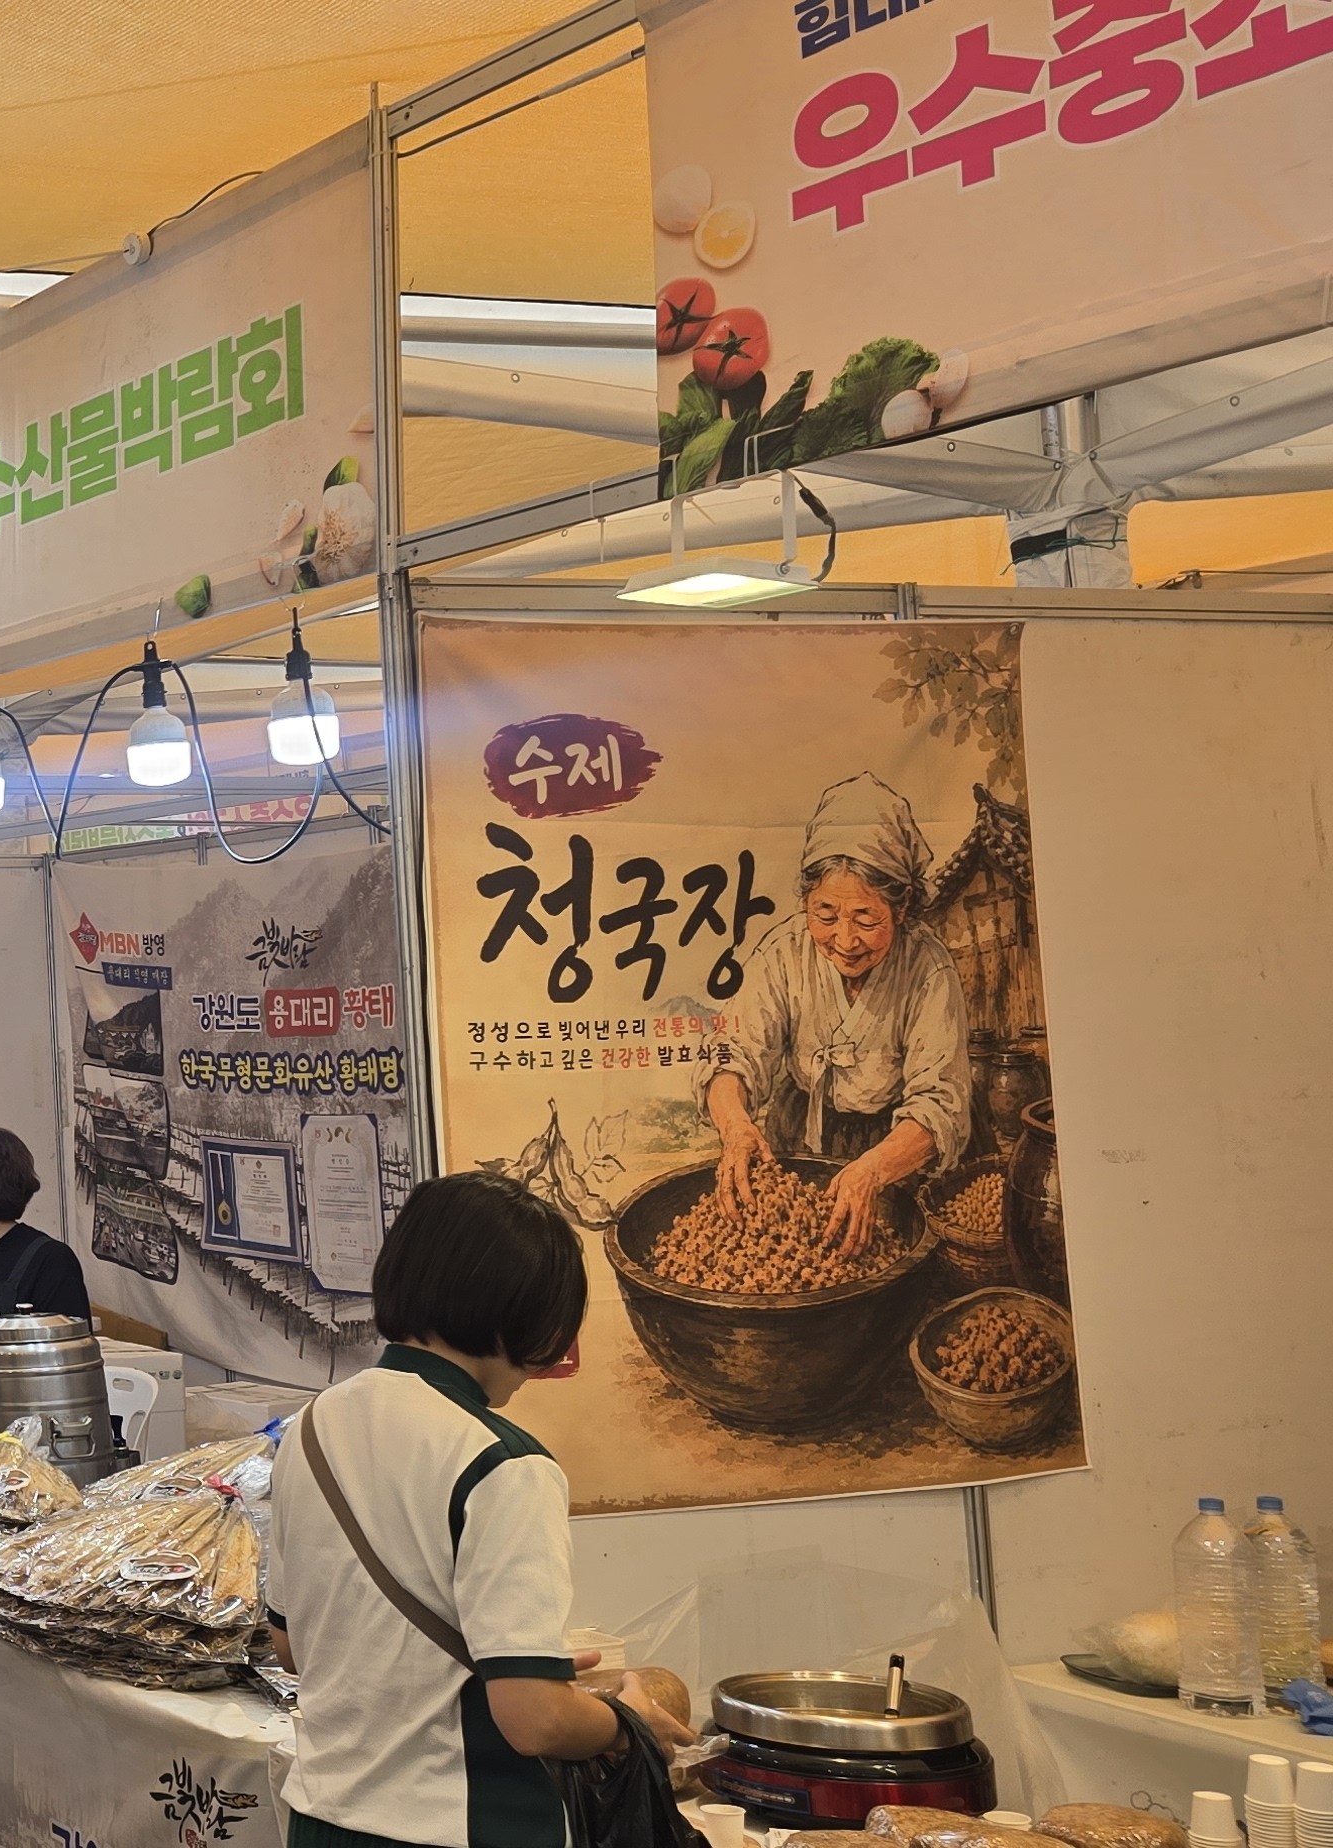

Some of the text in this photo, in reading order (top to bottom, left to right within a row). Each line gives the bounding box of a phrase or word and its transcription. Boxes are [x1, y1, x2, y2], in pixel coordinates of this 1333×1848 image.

[508, 734, 624, 806] 수제
[476, 822, 775, 1004] 청국장
[99, 931, 141, 956] MBN
[142, 933, 165, 956] 방영
[192, 985, 394, 1031] 강원도 용대리 황태
[467, 1021, 552, 1043] 정성으로
[558, 1020, 610, 1042] 빚어낸
[615, 1018, 646, 1039] 우리
[652, 1017, 704, 1038] 전통의
[180, 1051, 405, 1092] 한국무형문화유산 황태명
[469, 1043, 733, 1071] 구수하고 깊은 건강한 발효식품
